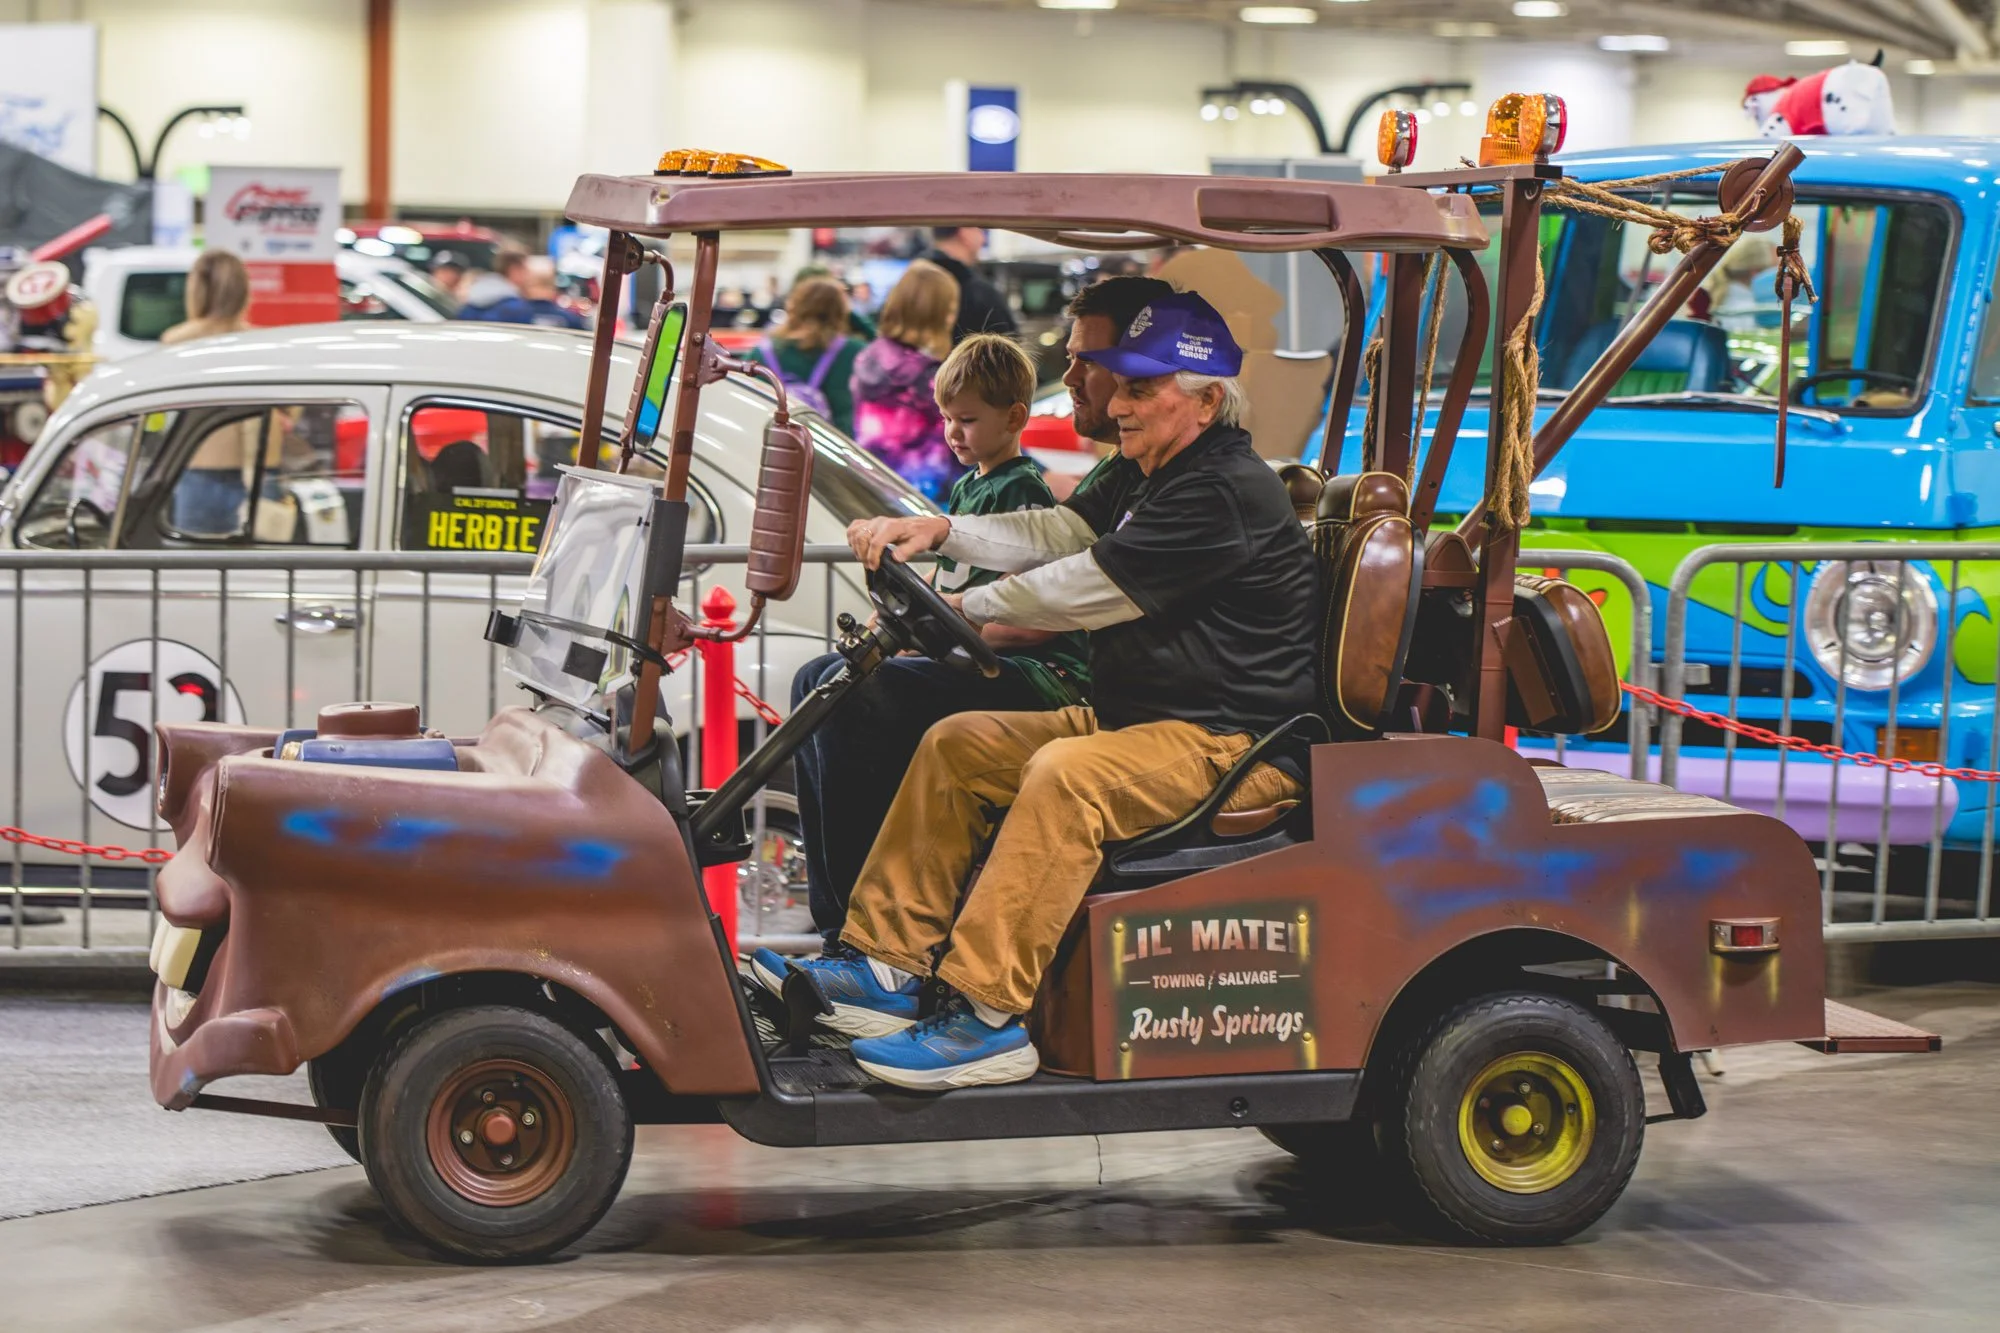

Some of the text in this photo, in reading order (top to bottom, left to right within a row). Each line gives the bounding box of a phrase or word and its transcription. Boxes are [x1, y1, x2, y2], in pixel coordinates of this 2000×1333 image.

[1176, 341, 1213, 354] EVERYDAY
[1179, 348, 1208, 360] HEROES
[428, 511, 540, 552] HERBIE
[1153, 974, 1205, 989] TOWING
[1218, 970, 1278, 986] SALVAGE
[1129, 1004, 1304, 1046] Rusty Springs
